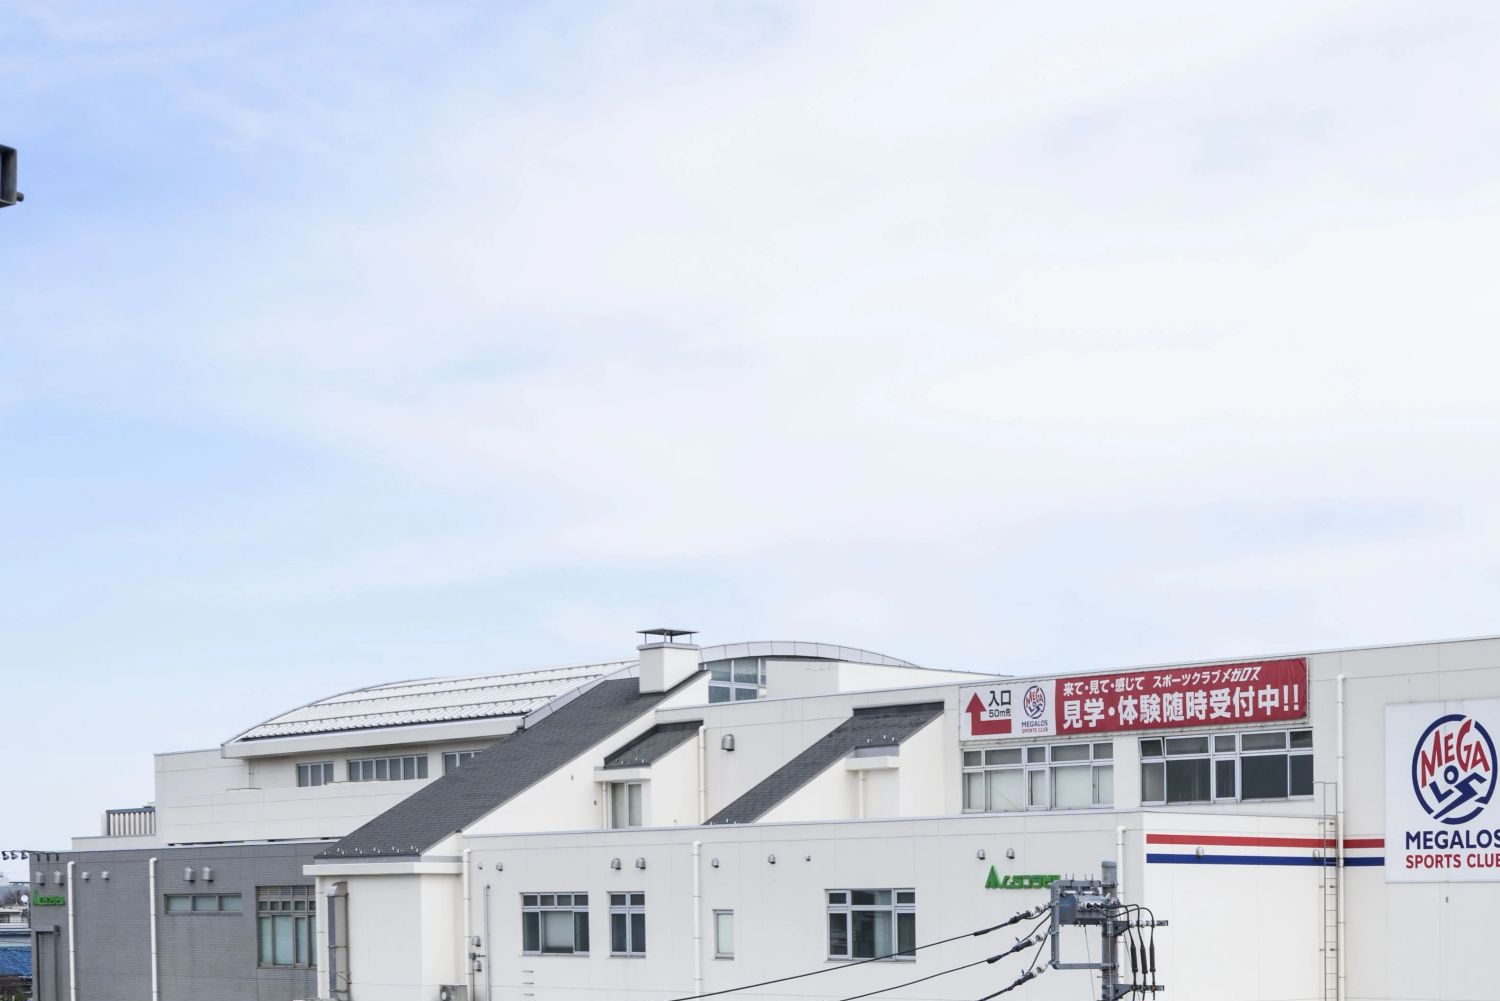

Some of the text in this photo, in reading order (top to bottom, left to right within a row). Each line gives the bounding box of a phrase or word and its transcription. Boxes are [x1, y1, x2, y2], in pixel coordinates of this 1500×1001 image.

[1064, 666, 1262, 697] 来て・見て・感じて スポーツクラブメガロス
[988, 690, 1012, 707] 入口
[1063, 684, 1299, 729] 見学・体験随時受付中!!
[988, 708, 1012, 718] 50m先
[1021, 719, 1048, 728] MEGALOS
[1421, 718, 1490, 788] MEGA
[1405, 854, 1461, 869] SPORTS
